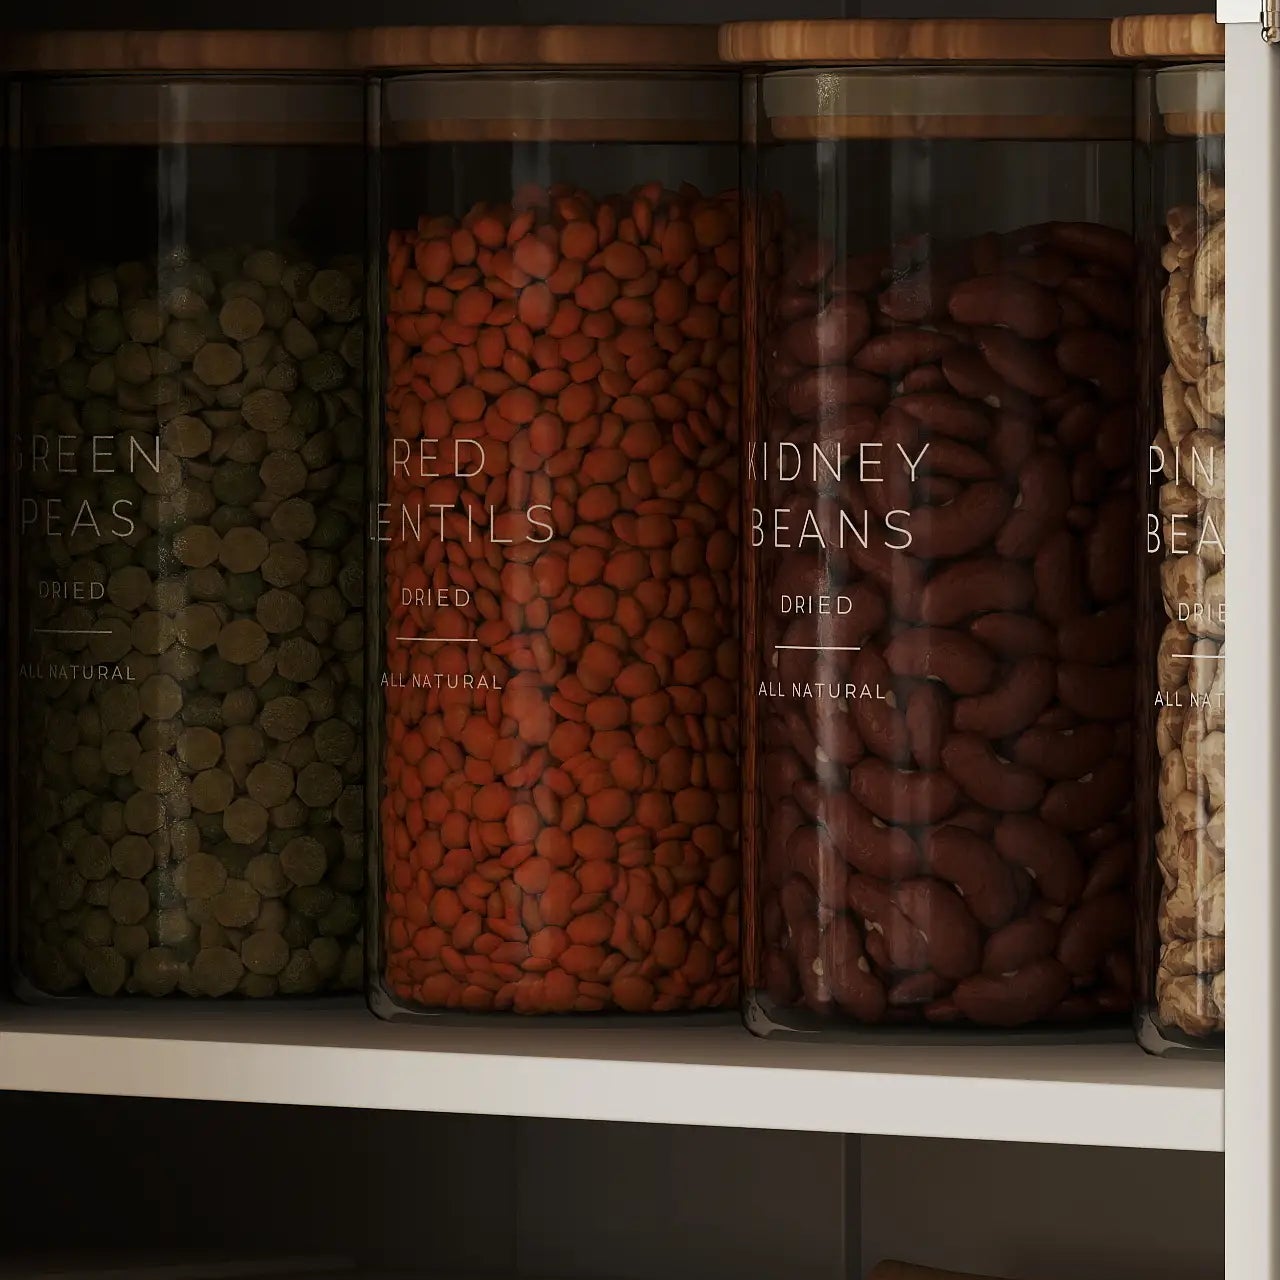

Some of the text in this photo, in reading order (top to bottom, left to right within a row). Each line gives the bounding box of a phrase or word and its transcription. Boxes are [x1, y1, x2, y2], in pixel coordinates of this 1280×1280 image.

[393, 438, 486, 477] RED
[748, 441, 929, 482] KIDNEY
[22, 498, 136, 537] PEAS
[751, 508, 913, 549] BEANS
[39, 581, 105, 600] DRIED
[402, 588, 470, 607] DRIED
[781, 595, 852, 614] DRIED
[19, 663, 136, 681] ALL NATURAL
[380, 672, 502, 689] ALL NATURAL
[758, 681, 885, 699] ALL NATURAL
[1154, 691, 1182, 707] ALL
